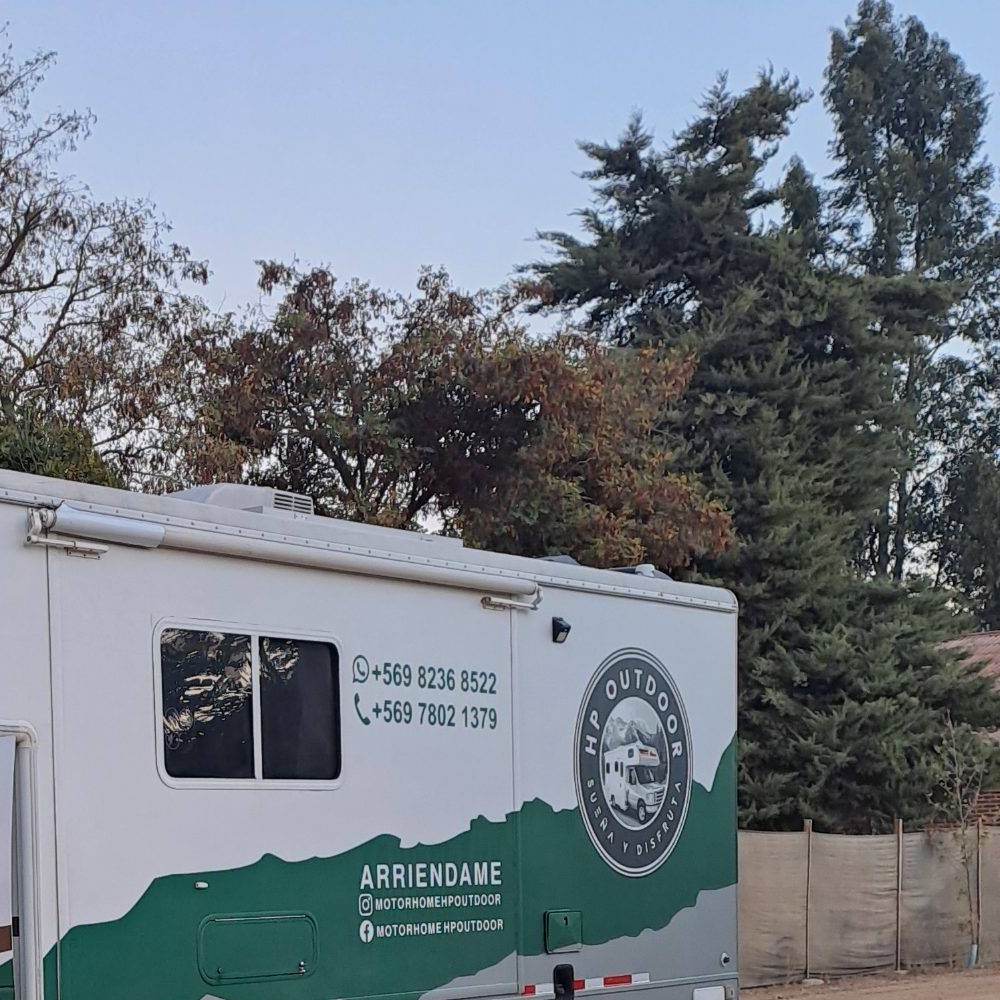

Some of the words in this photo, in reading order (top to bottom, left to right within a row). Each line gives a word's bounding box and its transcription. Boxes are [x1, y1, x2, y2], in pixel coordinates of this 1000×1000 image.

[371, 662, 412, 687] +569
[417, 665, 456, 691] 8236
[460, 670, 497, 694] 8522
[372, 700, 413, 724] +569
[417, 702, 456, 727] 7802
[461, 705, 498, 730] 1379
[584, 709, 601, 756] HP
[605, 669, 683, 758] OUTDOOR
[622, 841, 629, 853] Y
[636, 782, 682, 856] DISFRUTA
[360, 862, 502, 890] ARRIENDAME
[375, 894, 502, 911] MOTORHOMEHPOUTDOOR
